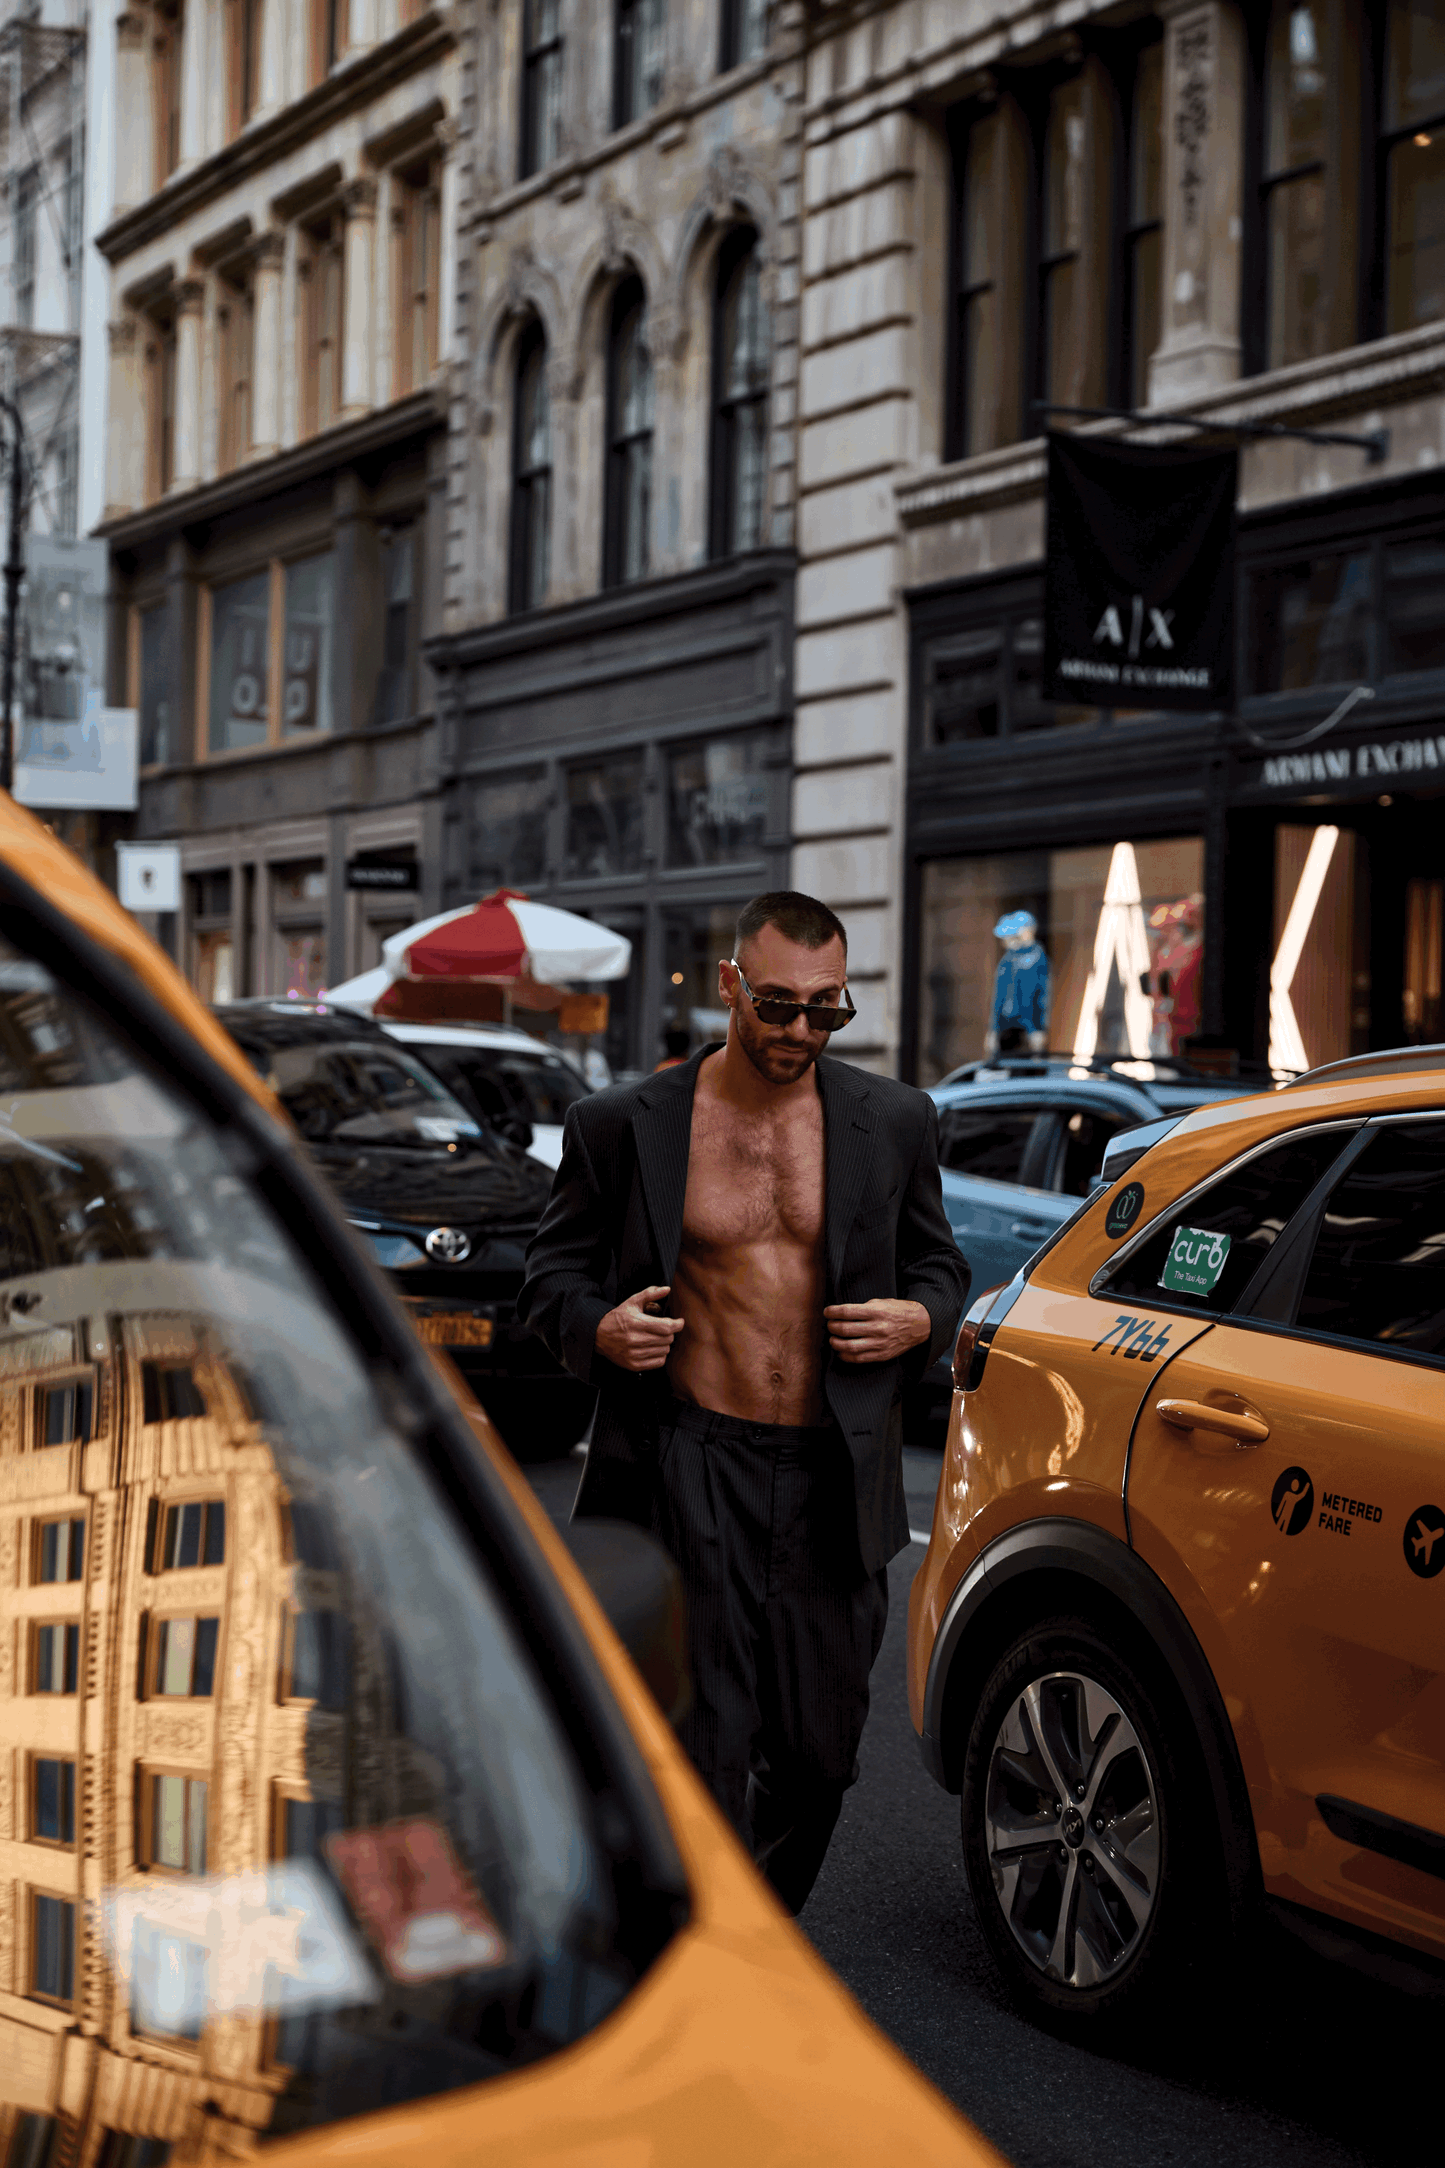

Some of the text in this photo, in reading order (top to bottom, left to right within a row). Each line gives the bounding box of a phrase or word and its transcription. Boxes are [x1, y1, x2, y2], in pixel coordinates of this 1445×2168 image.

[1260, 748, 1350, 787] ARMANI
[1174, 1240, 1223, 1269] curb
[1174, 1270, 1207, 1285] The Taxi App
[1091, 1315, 1173, 1362] 7Y66
[1321, 1491, 1383, 1523] METERED
[1318, 1512, 1352, 1536] FARE
